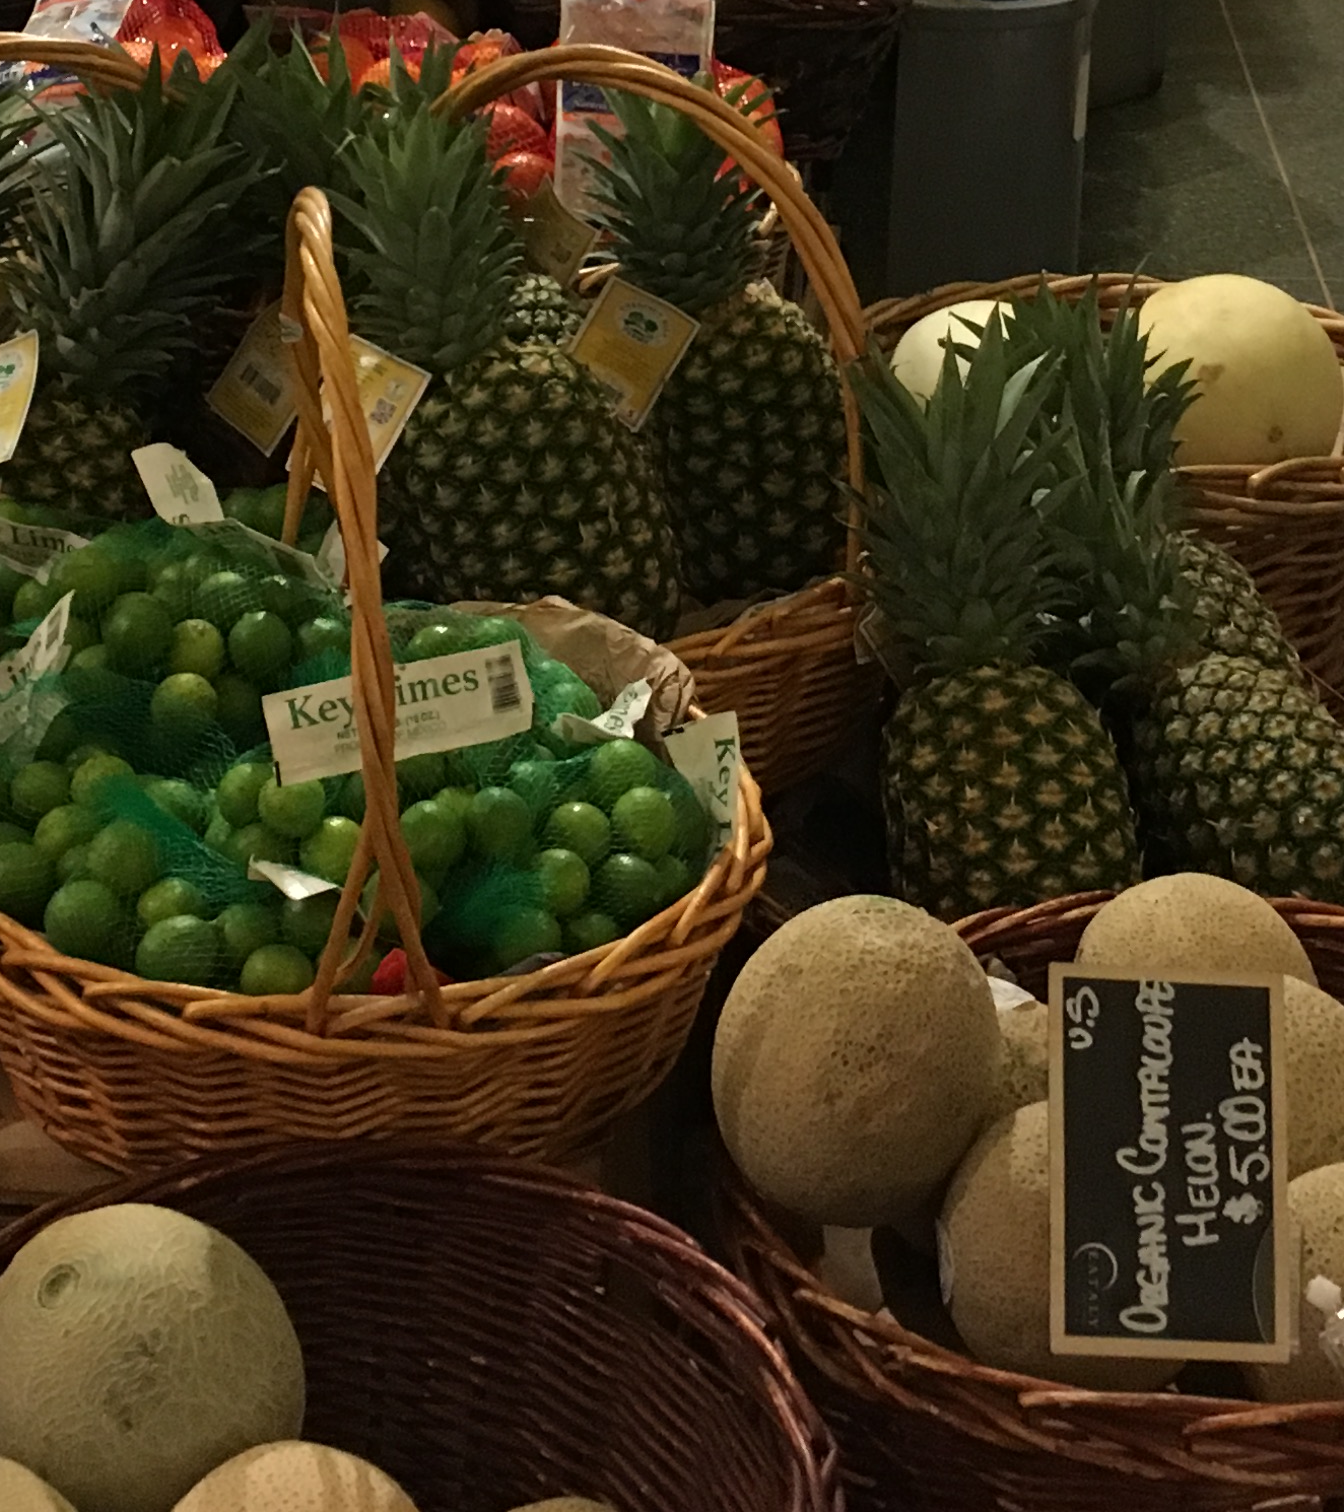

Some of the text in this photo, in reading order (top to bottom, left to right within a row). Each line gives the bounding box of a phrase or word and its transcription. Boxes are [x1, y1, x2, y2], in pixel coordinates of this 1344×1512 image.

[11, 525, 74, 554] Lim
[284, 666, 481, 731] Key imes
[712, 735, 737, 808] Key
[1118, 1181, 1171, 1335] ORGANIC
